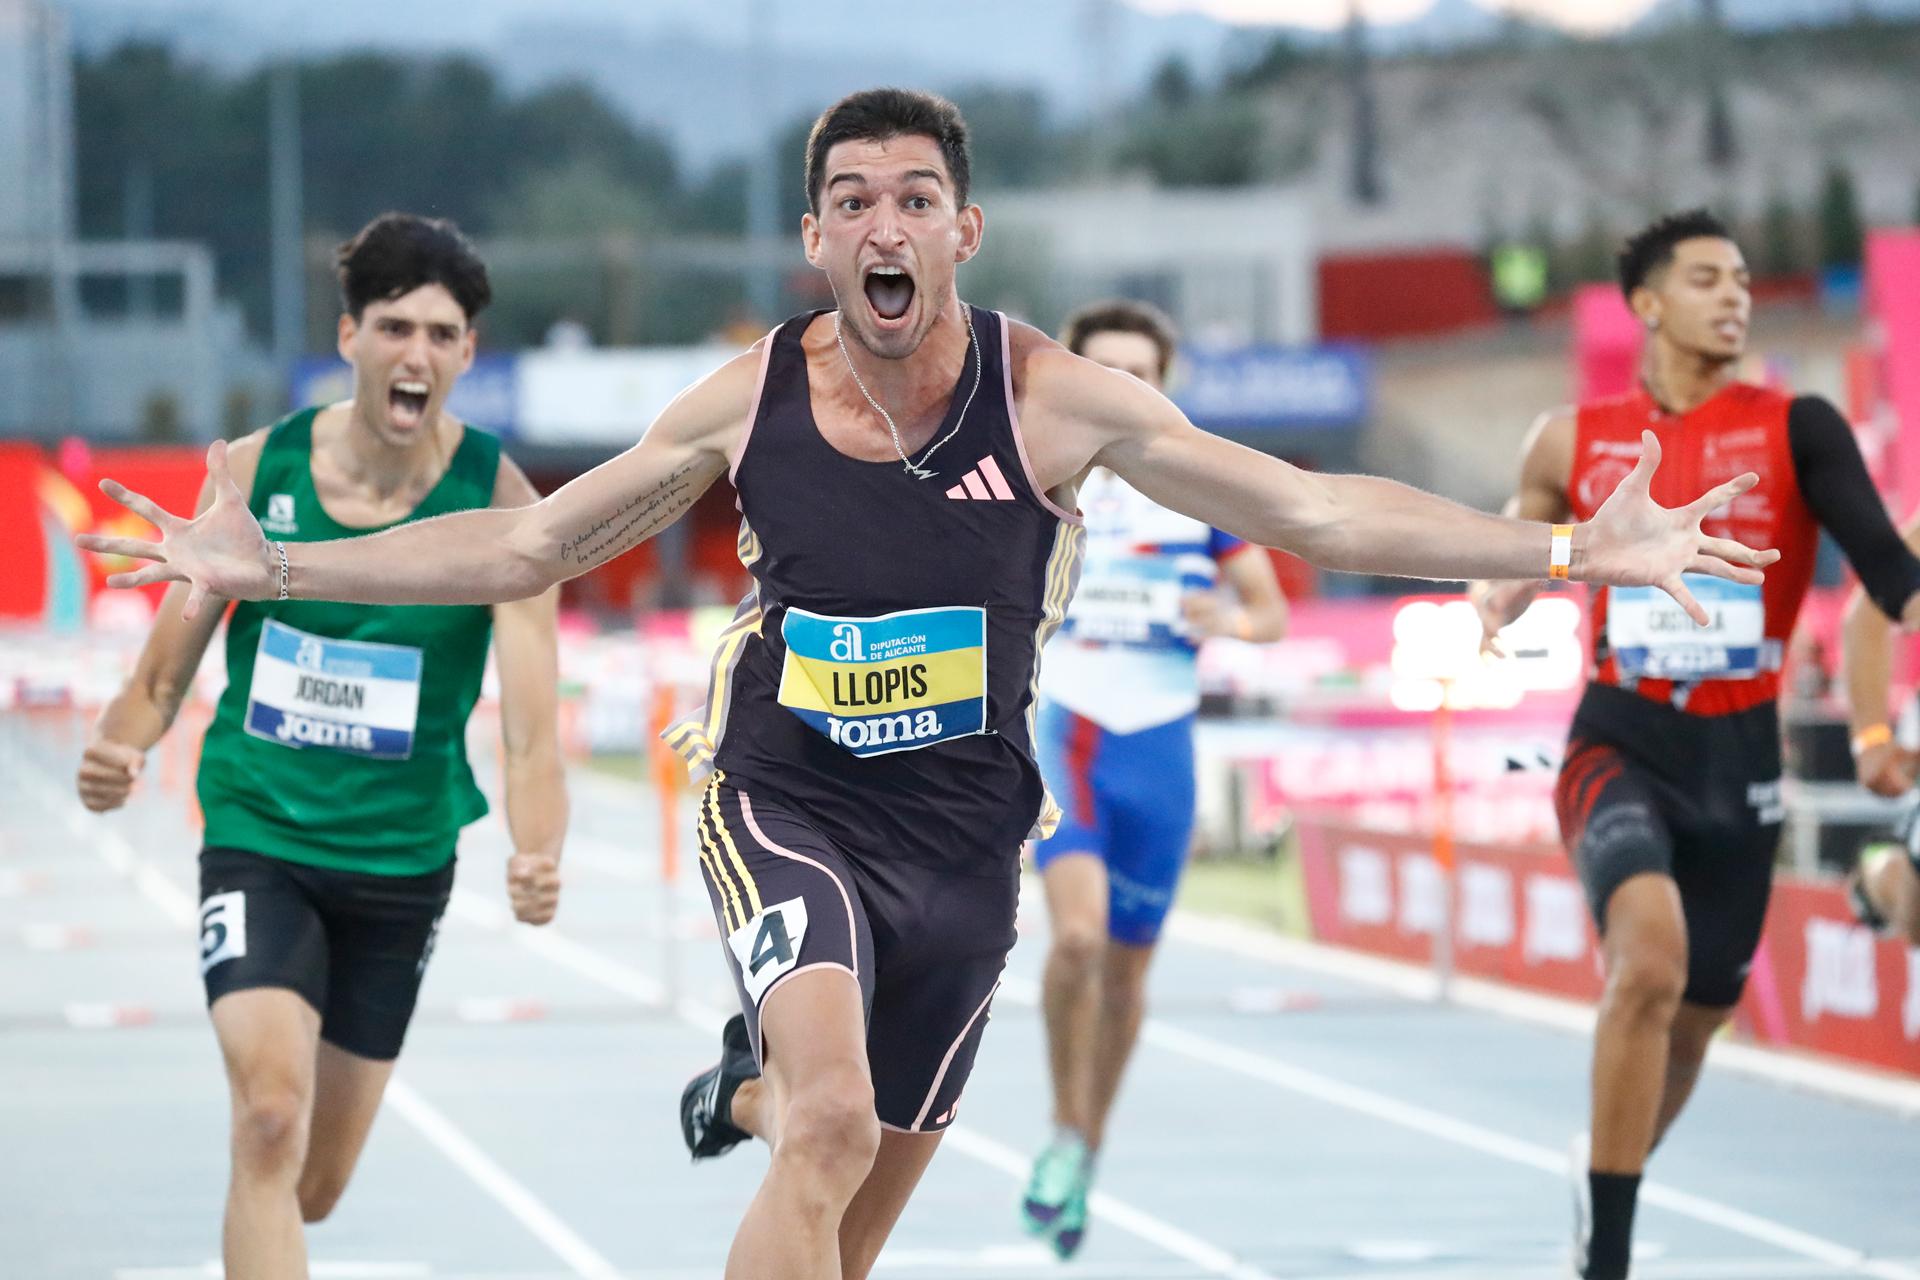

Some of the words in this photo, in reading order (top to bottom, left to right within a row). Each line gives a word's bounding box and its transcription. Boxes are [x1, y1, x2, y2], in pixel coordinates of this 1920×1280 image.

[870, 634, 926, 651] DIPUTACIÓN
[870, 652, 882, 660] DE
[884, 644, 926, 658] ALICANTE
[295, 675, 366, 709] JORDAN
[833, 664, 928, 706] LLOPIS
[276, 711, 375, 750] Joma
[202, 904, 228, 959] 5
[749, 910, 794, 978] 4
